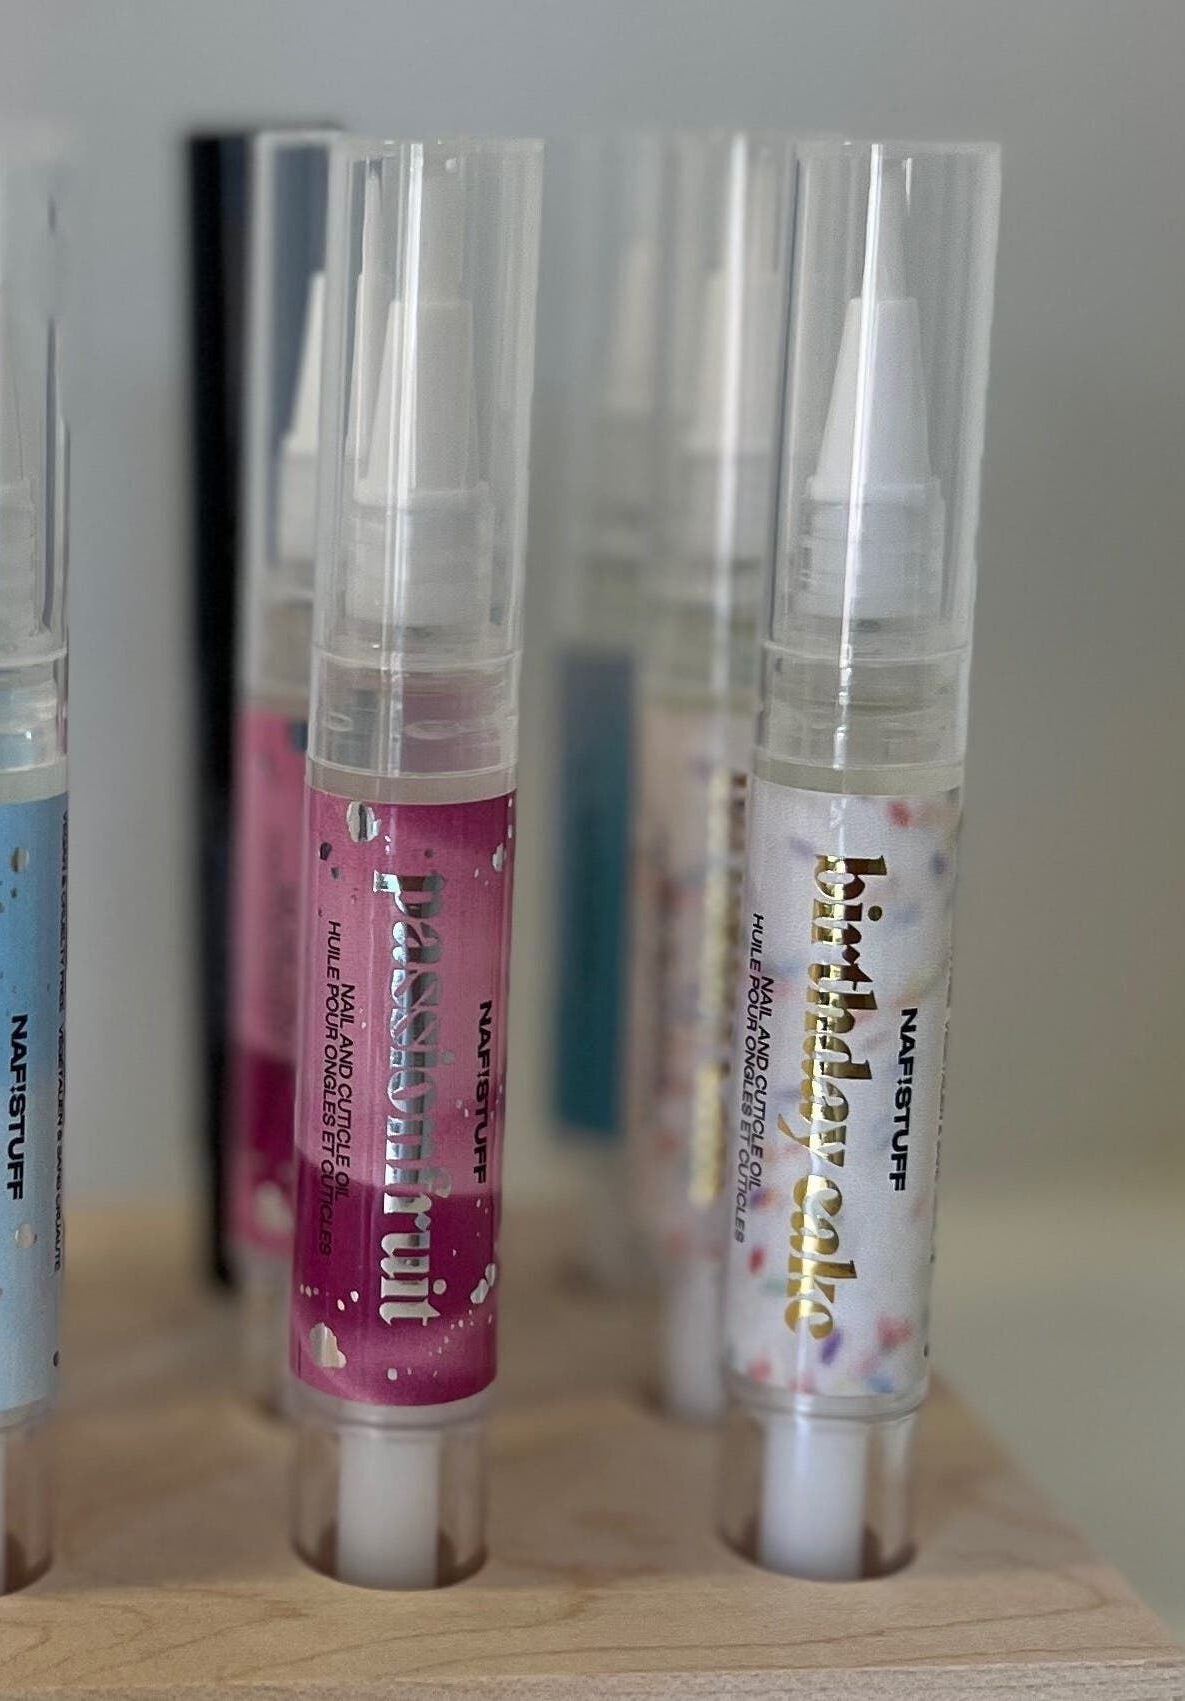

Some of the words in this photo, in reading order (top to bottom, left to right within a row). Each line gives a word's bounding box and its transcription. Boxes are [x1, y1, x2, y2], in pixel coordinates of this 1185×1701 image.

[327, 920, 341, 980] HUILE
[749, 913, 764, 972] HUILE
[325, 984, 339, 1040] POUR
[339, 984, 355, 1028] NAIL
[746, 974, 760, 1032] POUR
[759, 976, 775, 1021] NAIL
[777, 854, 887, 1168] birthday
[339, 1034, 353, 1080] AND
[742, 1036, 756, 1116] ONGLES
[755, 1026, 771, 1070] AND
[7, 1014, 28, 1200] NAF!STUFF
[323, 1044, 337, 1126] ONGLES
[373, 870, 455, 1326] passionfruit
[473, 1000, 493, 1184] NAF!STUFF
[751, 1074, 768, 1158] CUTICLE
[889, 1008, 918, 1191] NAF!STUFF
[322, 1130, 335, 1157] ET
[335, 1084, 353, 1168] CUTICLE
[739, 1120, 751, 1146] ET
[319, 1160, 334, 1256] CUTICLES
[335, 1172, 349, 1201] OIL
[734, 1148, 750, 1243] CUTICLES
[749, 1162, 763, 1192] OIL
[783, 1174, 858, 1338] cake
